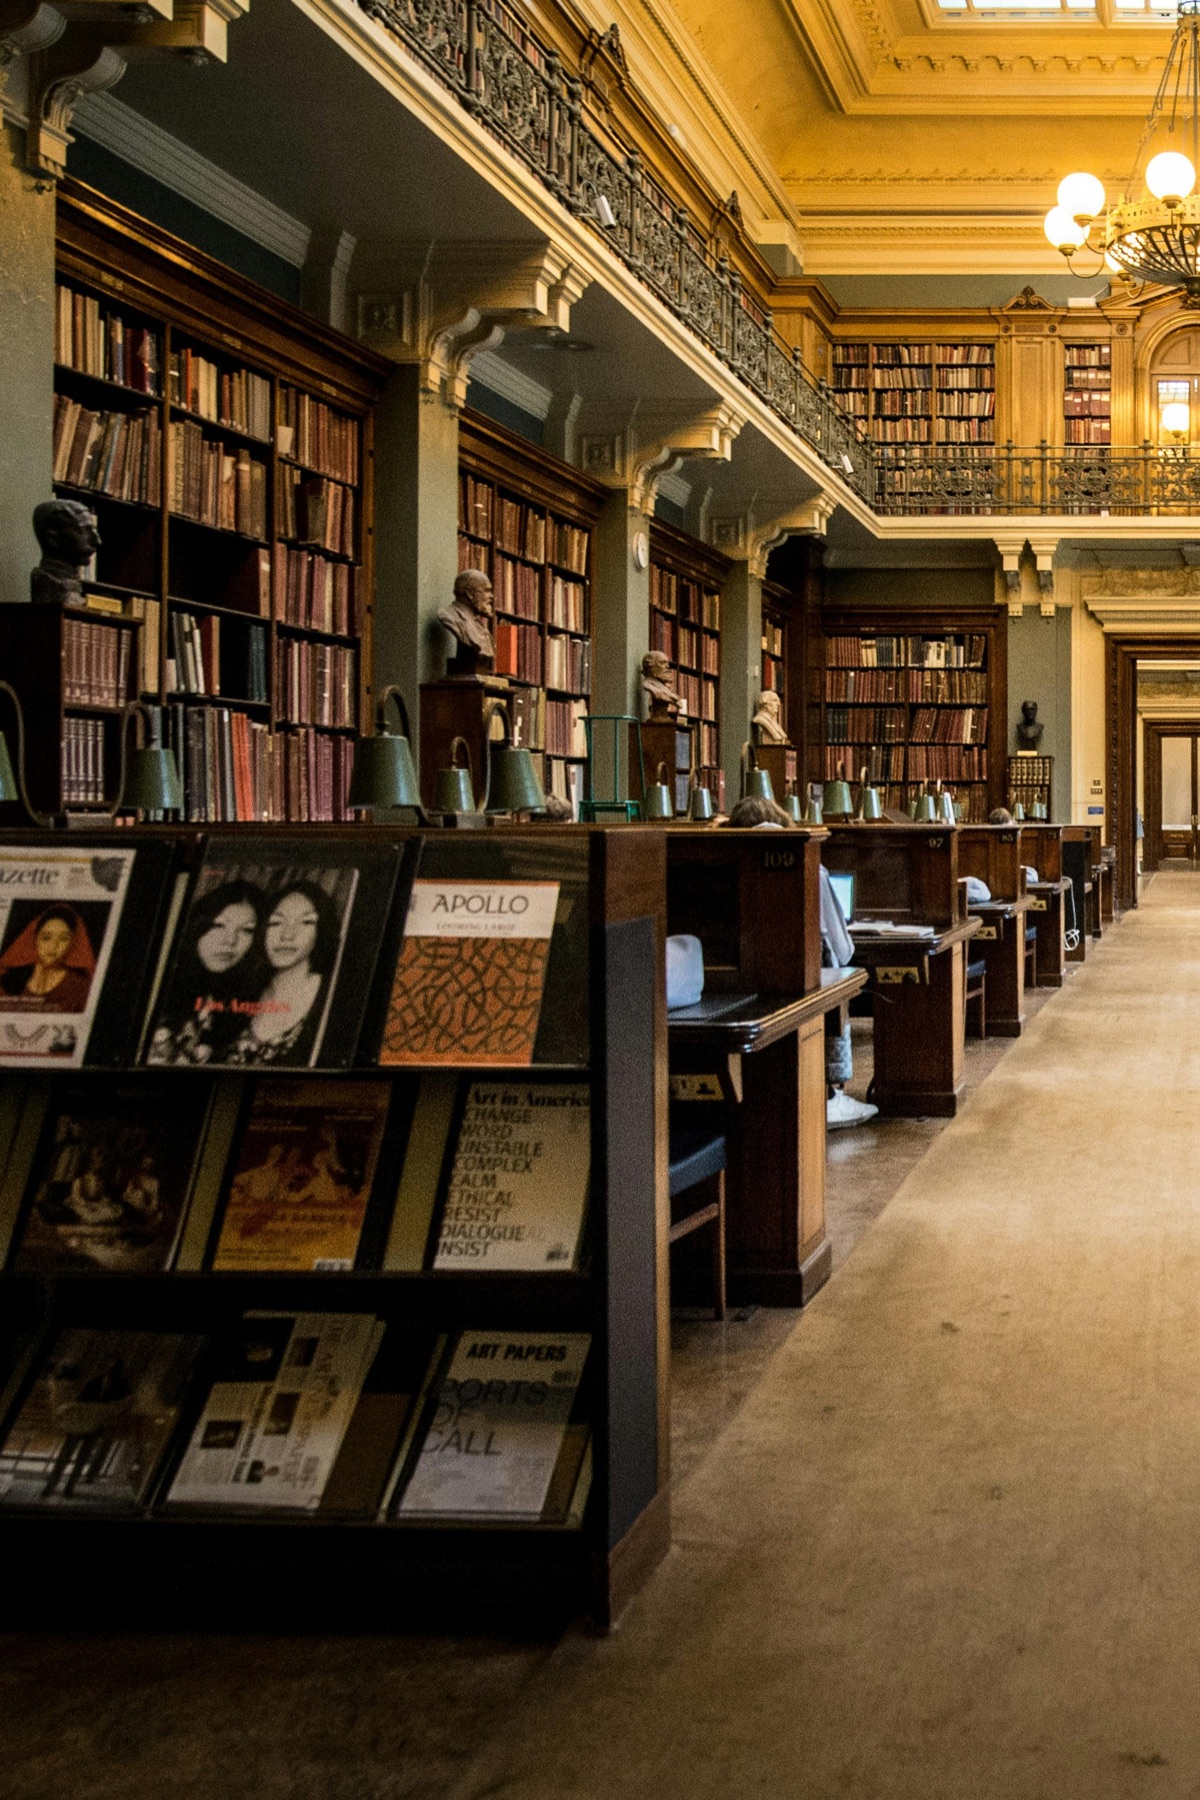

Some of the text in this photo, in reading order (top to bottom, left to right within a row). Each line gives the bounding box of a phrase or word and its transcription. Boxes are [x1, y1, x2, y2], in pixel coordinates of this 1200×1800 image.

[431, 893, 530, 915] APOLLO
[474, 1089, 497, 1105] Art
[501, 1091, 519, 1106] in
[440, 1223, 526, 1241] DIALOGUE
[438, 1240, 492, 1257] NSIST
[467, 1343, 567, 1361] ART PAPERS
[422, 1428, 503, 1456] CALL
